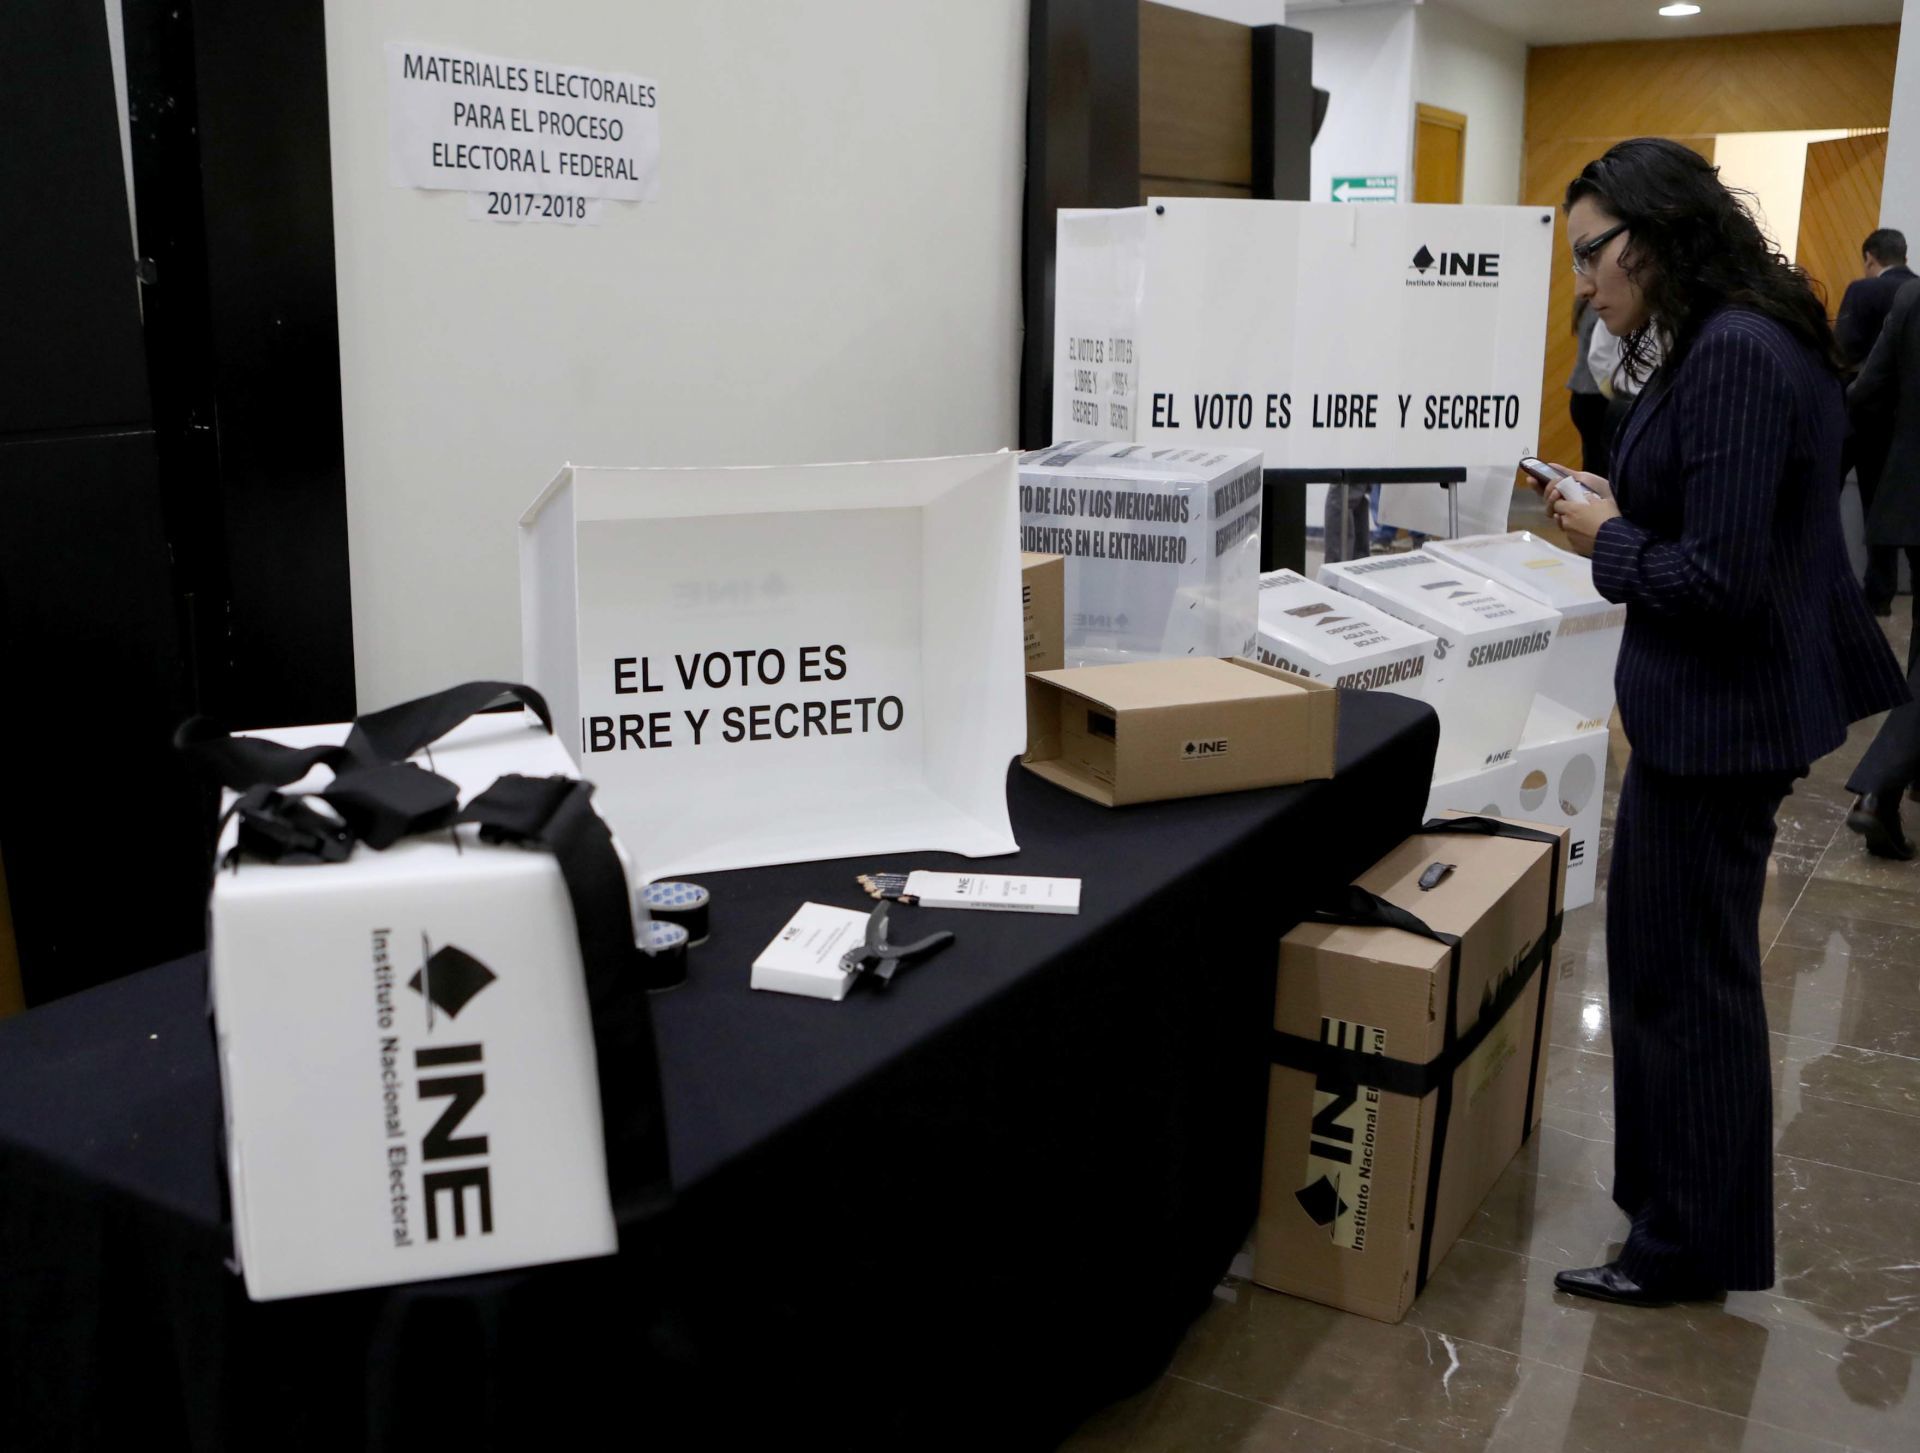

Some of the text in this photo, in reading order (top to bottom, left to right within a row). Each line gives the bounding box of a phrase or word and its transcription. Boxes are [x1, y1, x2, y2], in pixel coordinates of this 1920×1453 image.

[403, 53, 656, 108] MATERIALES ELECTORALES
[453, 102, 624, 142] PARA EL PROCESO
[559, 152, 639, 181] FEDERAL
[487, 191, 586, 219] 2017-2018
[1439, 252, 1500, 277] INE
[1405, 279, 1435, 287] Instituto
[1437, 280, 1467, 288] Nacional
[1069, 337, 1077, 361] EL
[1151, 393, 1520, 430] EL VOTO ES LIBRE Y SECRETO
[1035, 486, 1051, 514] DE
[1053, 488, 1076, 516] LAS
[1079, 489, 1087, 517] Y
[1088, 490, 1112, 519] LOS
[1114, 491, 1189, 524] MEXICANOS
[1075, 529, 1090, 557] EN
[1093, 530, 1105, 558] EL
[1108, 531, 1187, 565] EXTRANJERO
[1467, 630, 1551, 668] SENADURÍAS
[614, 644, 847, 694] EL VOTO ES
[1336, 655, 1425, 691] PRESIDENCIA
[684, 709, 710, 745] Y
[722, 695, 904, 743] SECRETO
[1198, 740, 1228, 754] INE
[1493, 748, 1512, 763] INE
[371, 928, 413, 1248] Instituto Nacional Electoral
[1310, 1016, 1365, 1165] INE
[413, 1042, 494, 1242] INE
[1351, 1027, 1385, 1252] Instituto Nacional Elral
